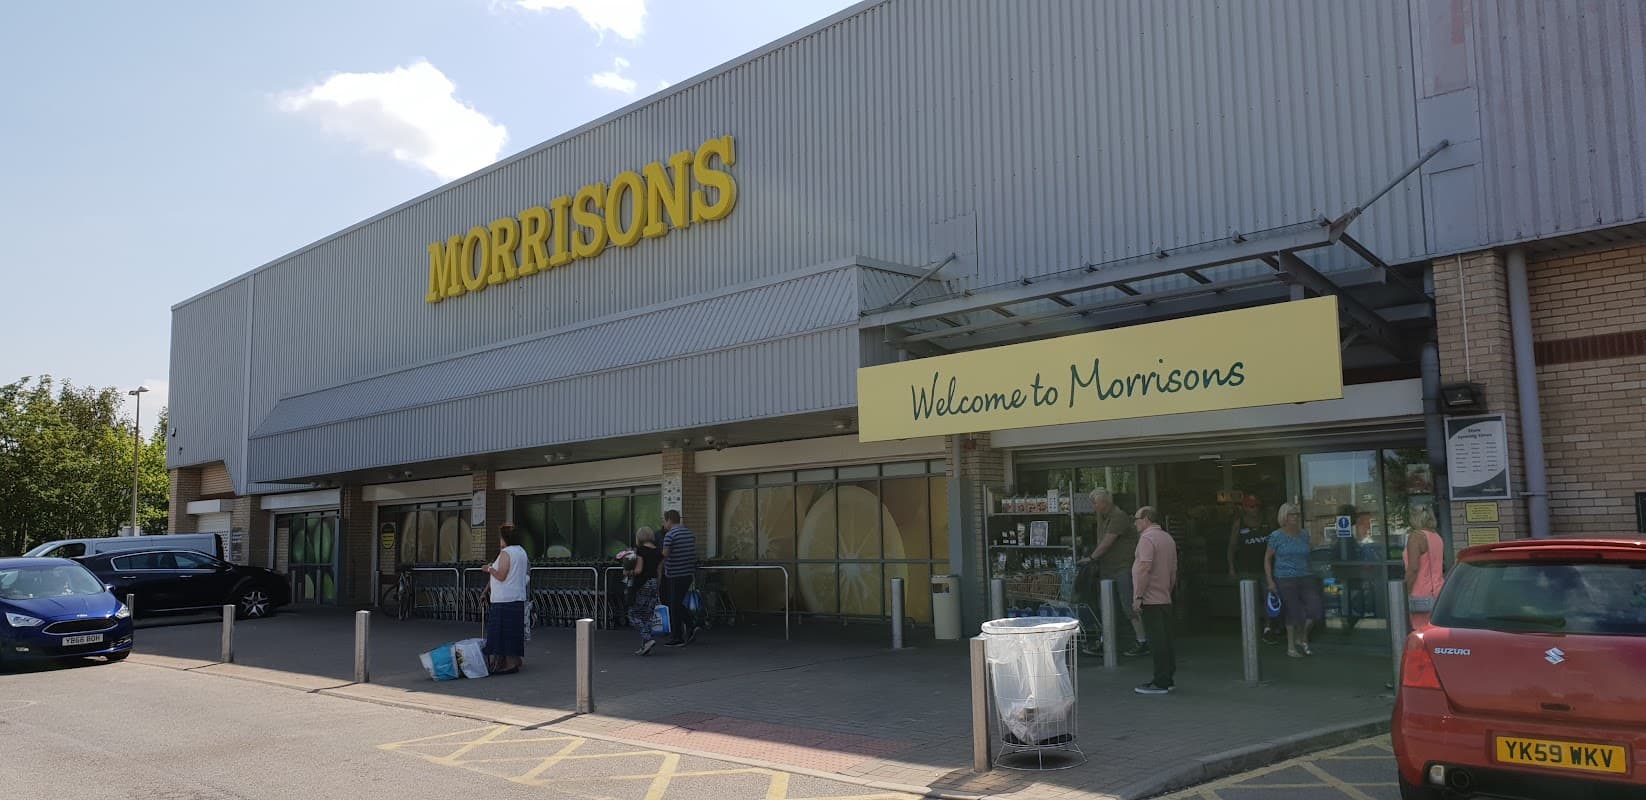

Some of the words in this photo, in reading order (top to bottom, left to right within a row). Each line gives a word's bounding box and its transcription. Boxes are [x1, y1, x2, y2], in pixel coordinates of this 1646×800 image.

[426, 135, 737, 304] MORRISONS
[911, 371, 1027, 421] Welcome
[1030, 372, 1058, 407] to
[1069, 358, 1245, 408] Morrisons
[1433, 647, 1471, 656] SUZUKI
[1505, 740, 1562, 763] YK59
[1569, 746, 1613, 768] WKV
